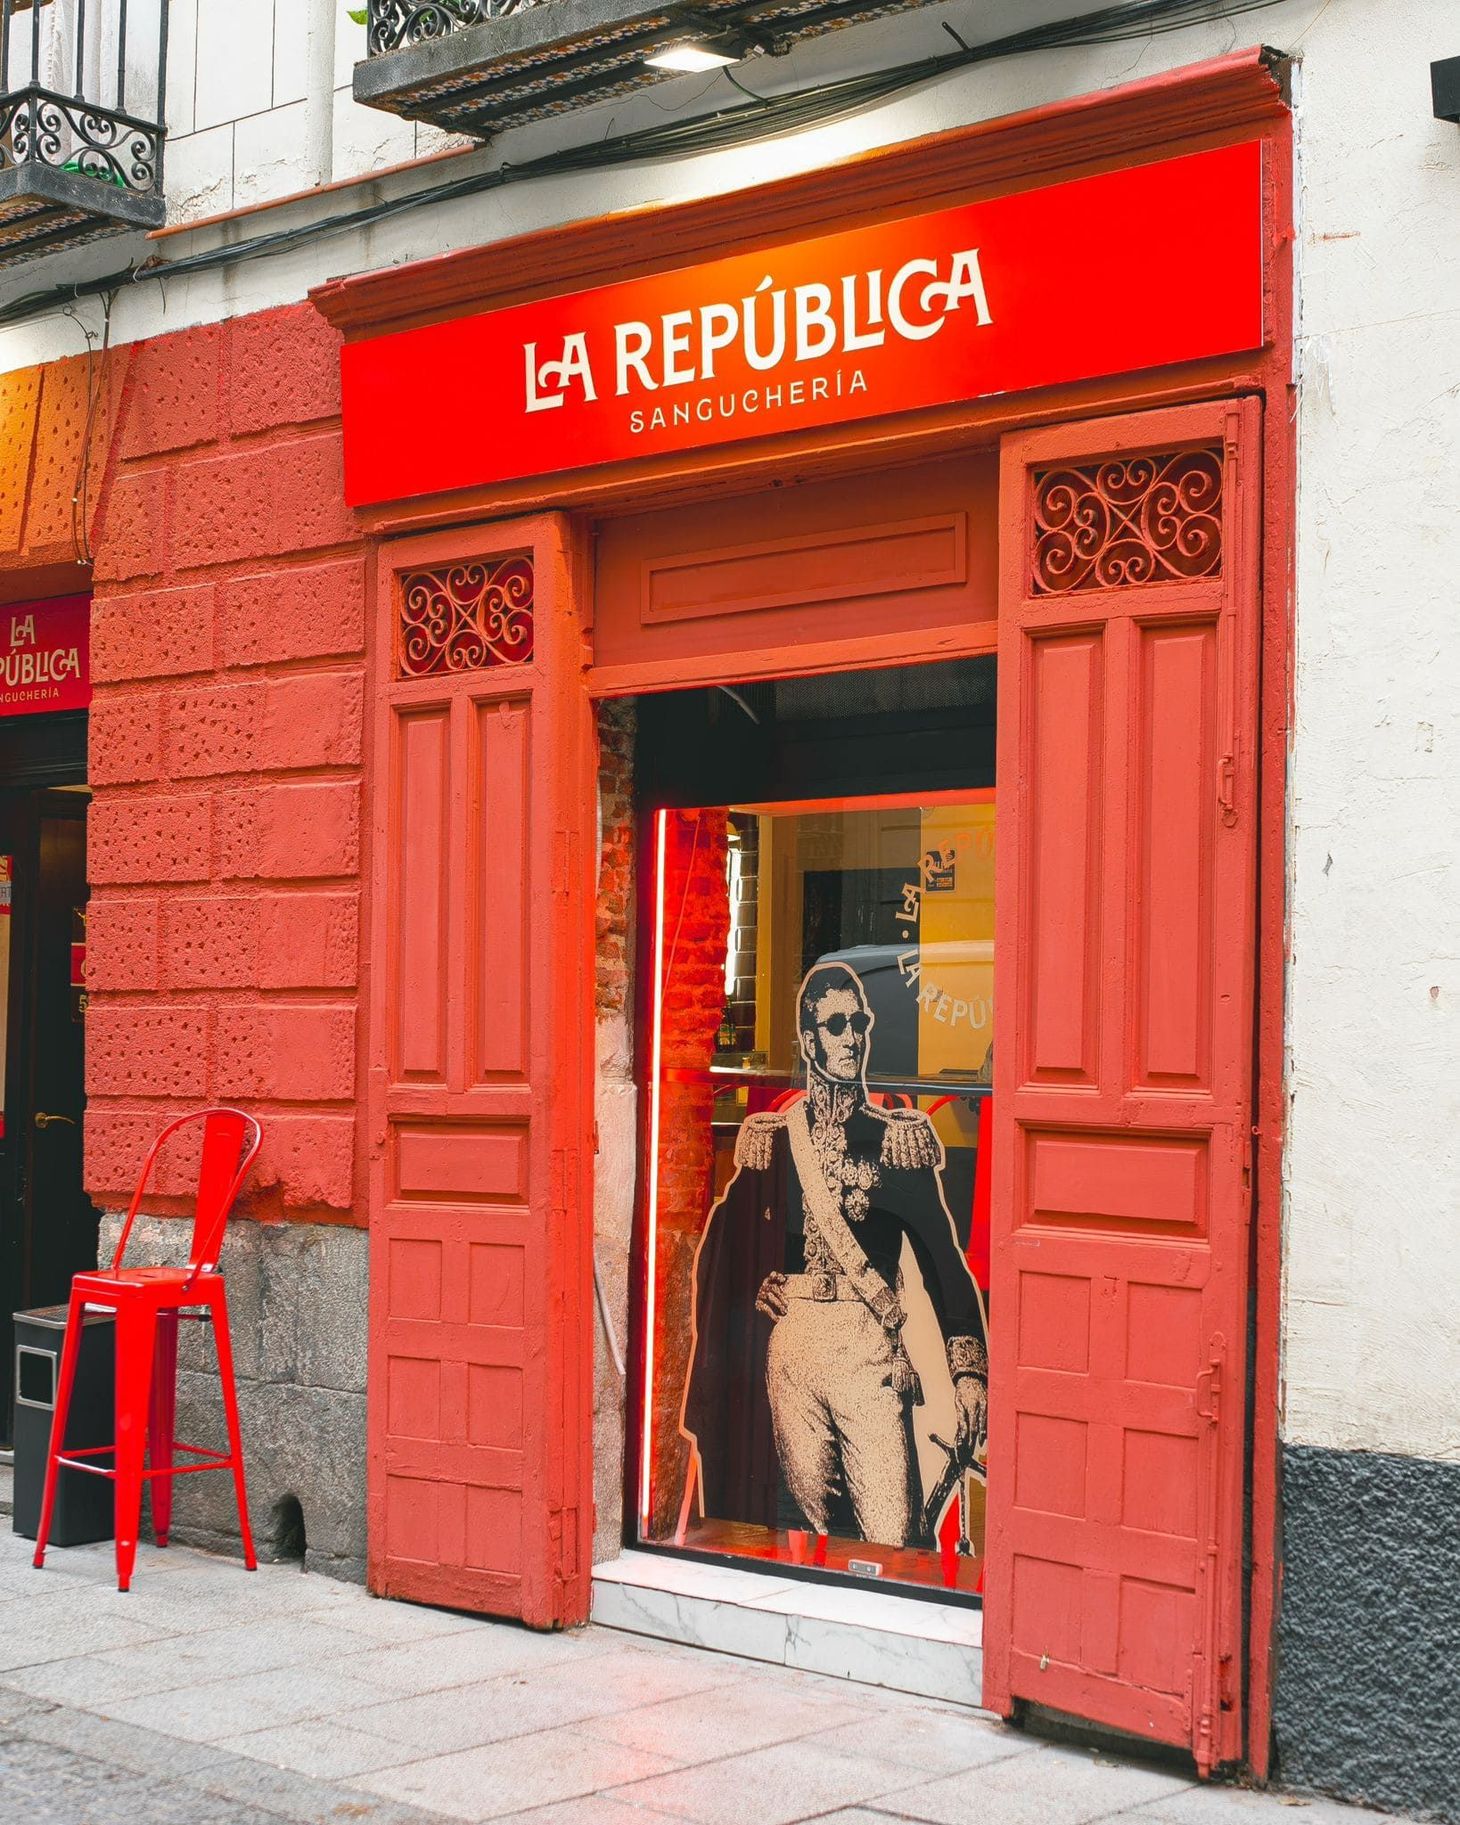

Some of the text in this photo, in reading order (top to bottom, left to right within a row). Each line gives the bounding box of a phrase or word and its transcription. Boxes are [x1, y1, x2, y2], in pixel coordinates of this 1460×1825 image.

[524, 248, 993, 413] LA REPÚBLICA
[629, 369, 868, 433] SANGUCHERÍA
[10, 614, 36, 647] LA
[895, 882, 927, 922] LA
[896, 949, 994, 1029] LA REPÚ
